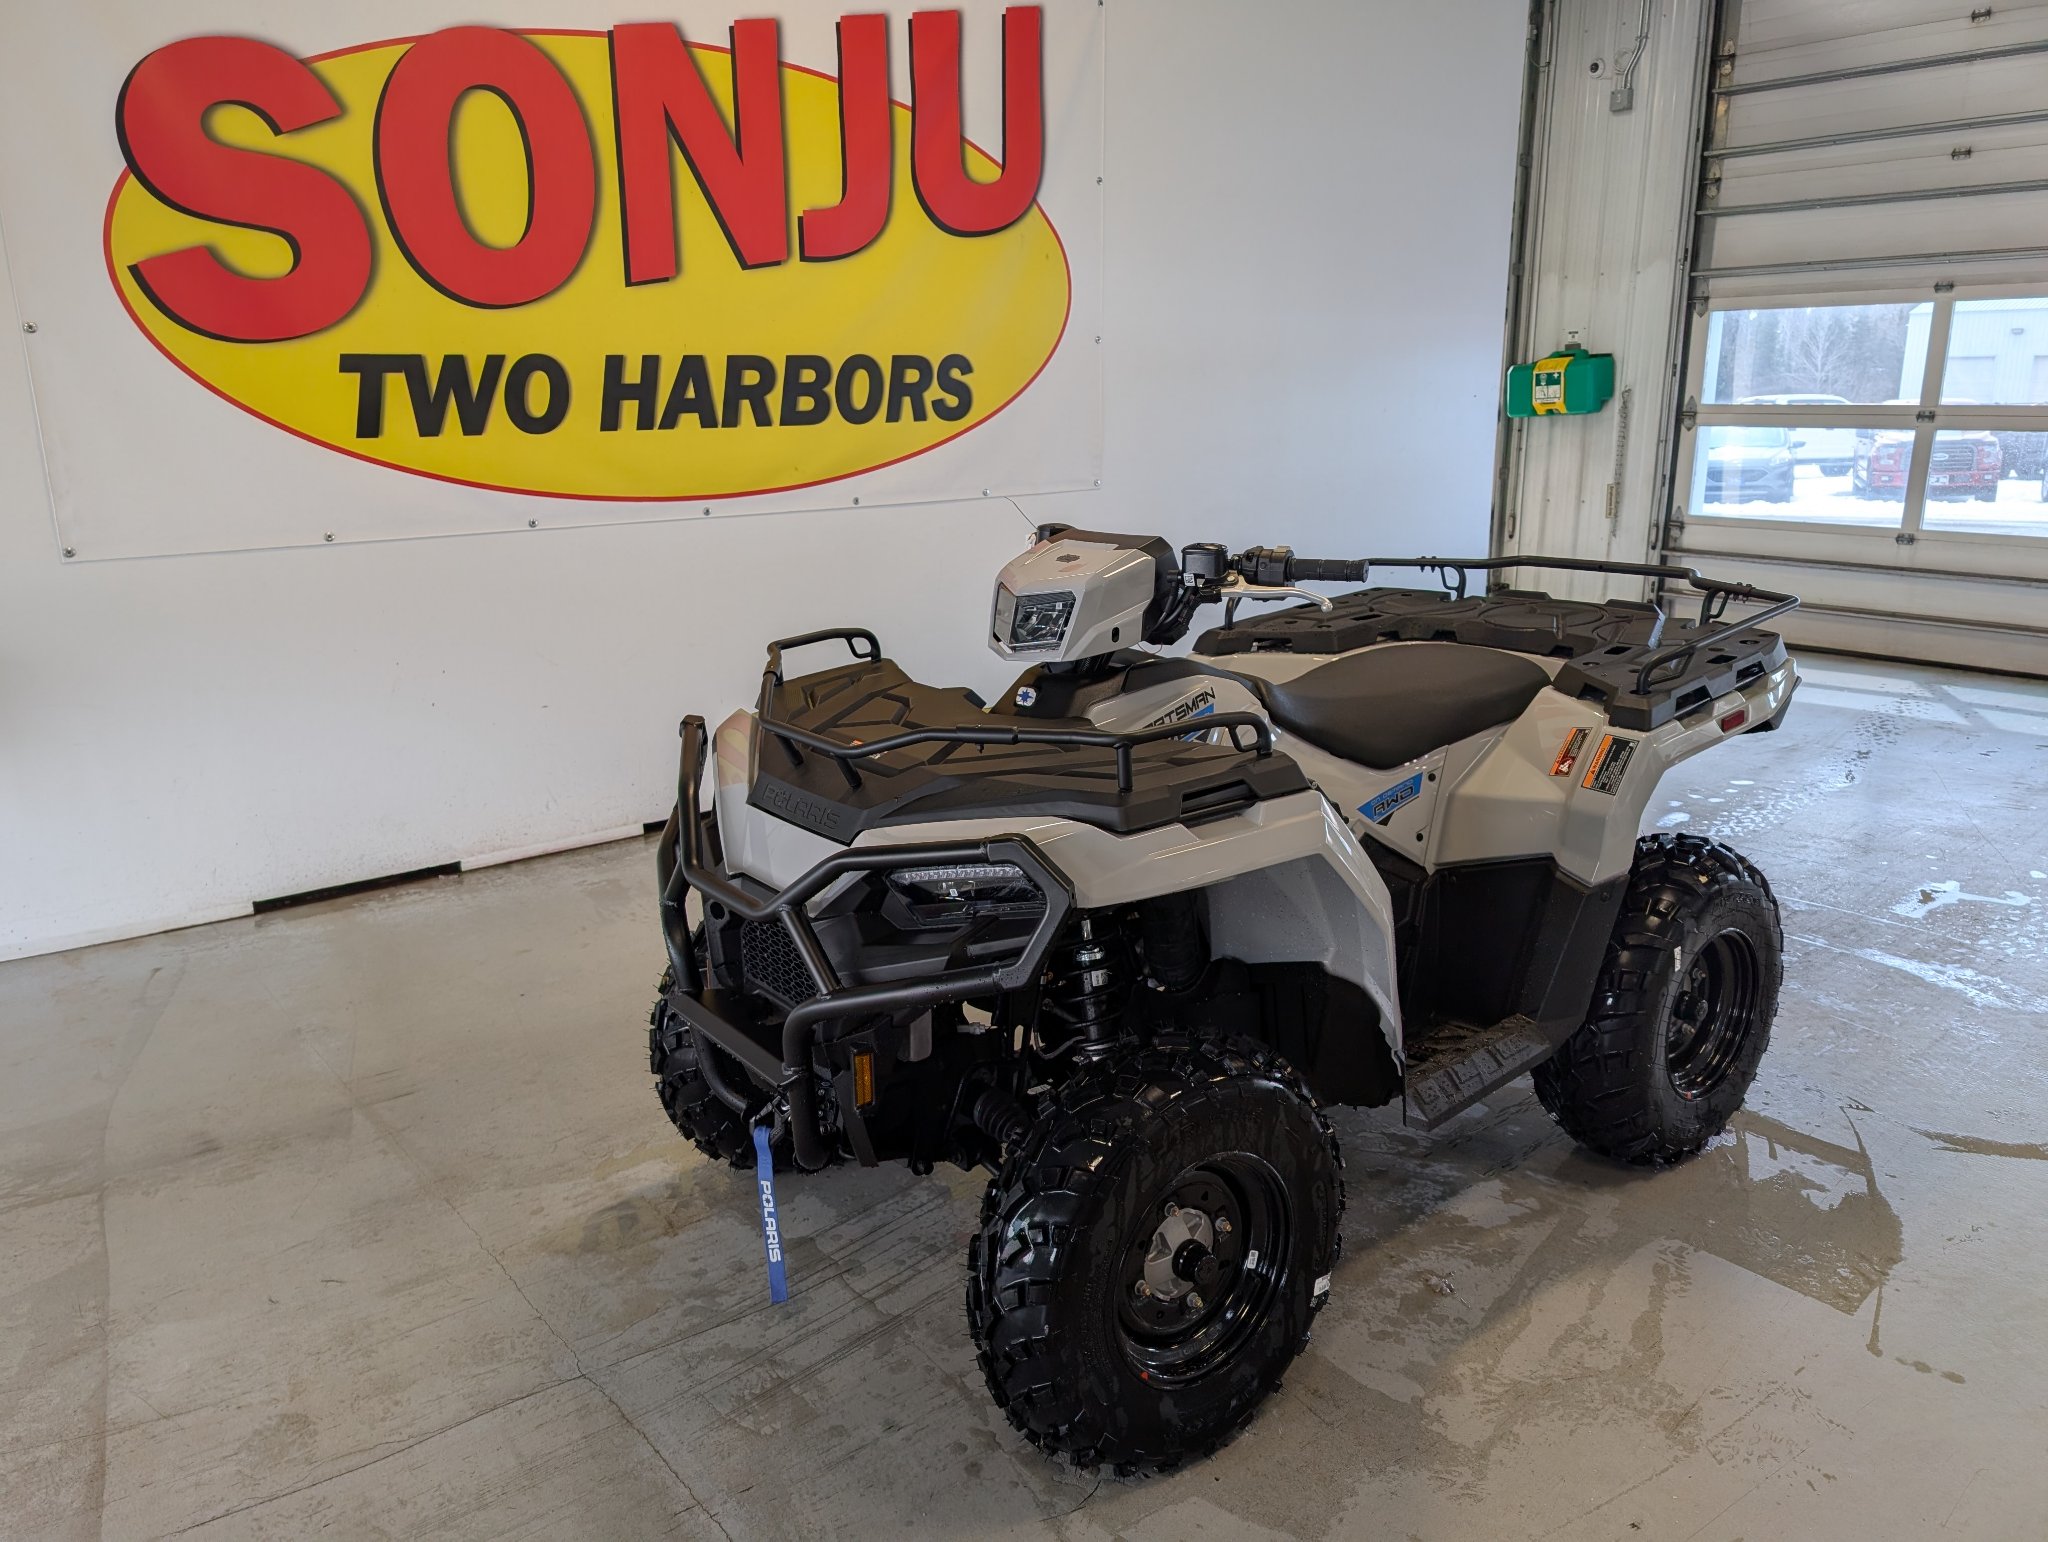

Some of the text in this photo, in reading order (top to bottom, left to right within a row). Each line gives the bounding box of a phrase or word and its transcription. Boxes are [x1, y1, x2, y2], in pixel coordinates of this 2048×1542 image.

[116, 6, 1043, 343] SONJU
[338, 352, 974, 439] TWO HARBORS
[762, 783, 841, 829] POLARIS
[1372, 785, 1415, 816] AWD
[761, 1180, 782, 1263] POLARIS
